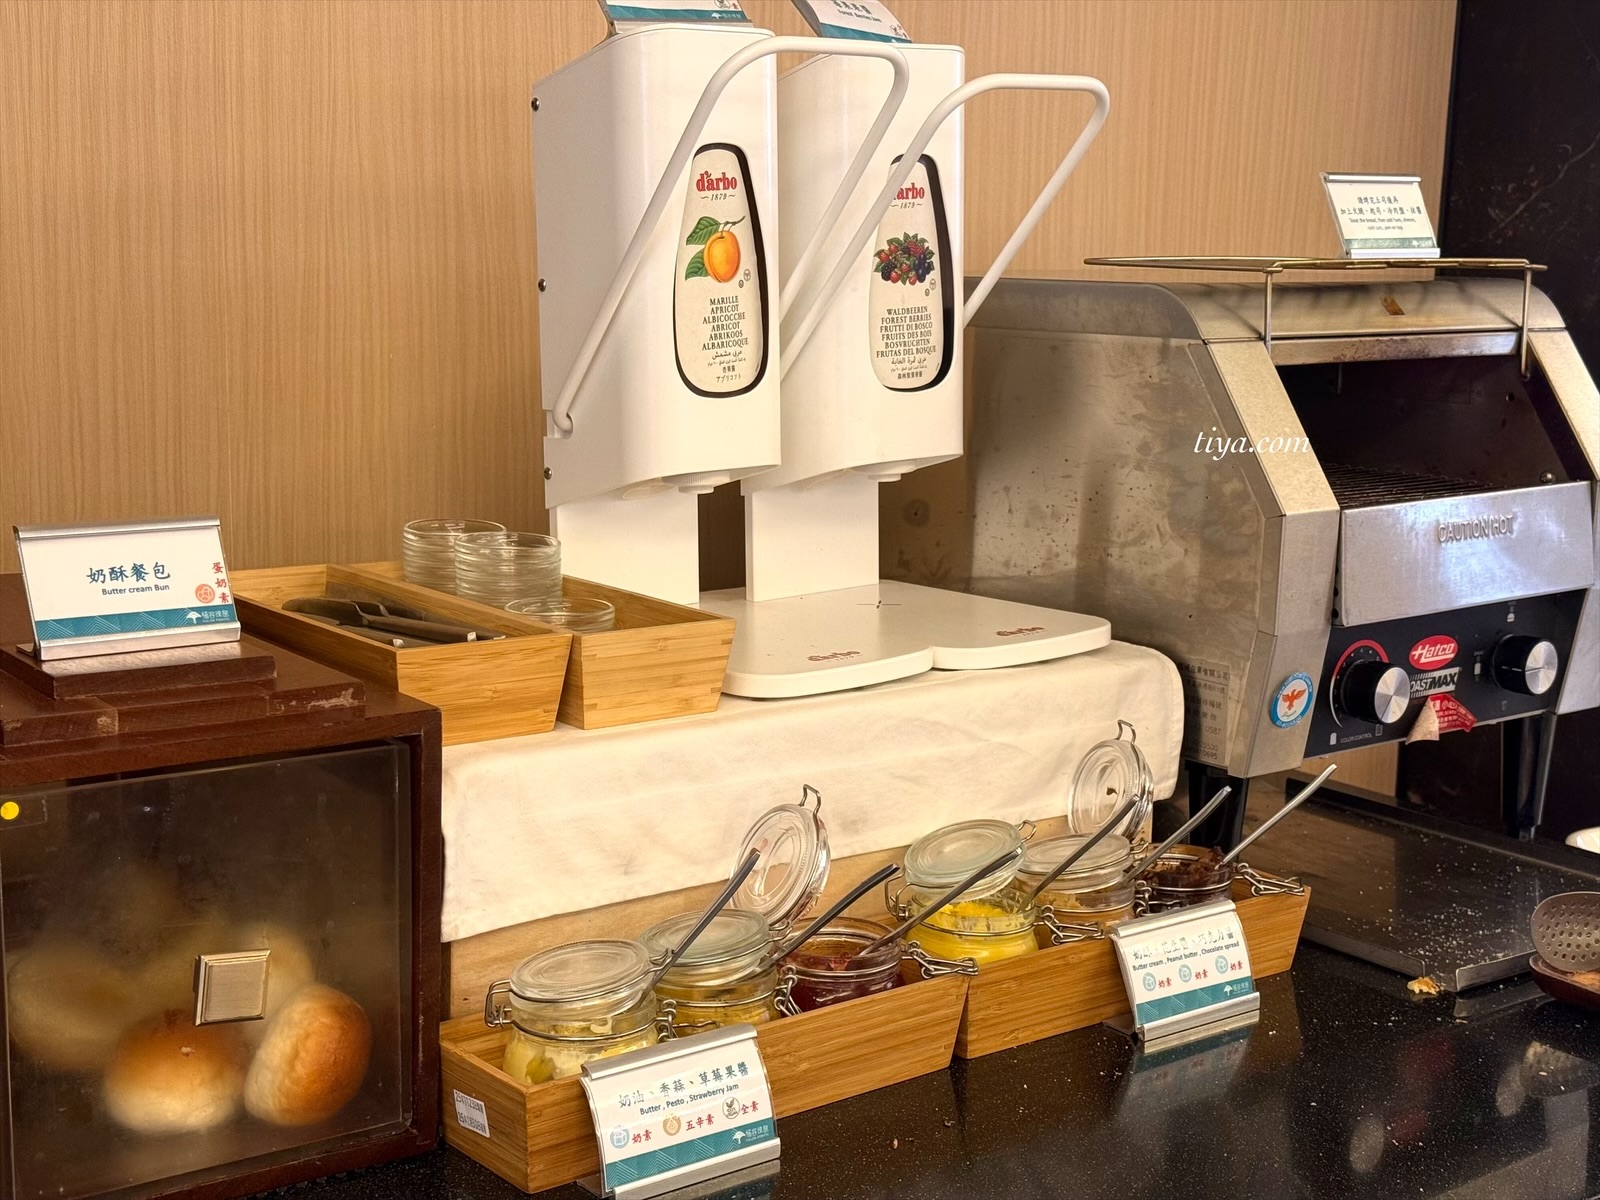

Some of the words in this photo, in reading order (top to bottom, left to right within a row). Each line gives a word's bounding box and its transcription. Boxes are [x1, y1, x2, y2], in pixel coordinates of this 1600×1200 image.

[894, 182, 925, 200] arbo
[710, 296, 739, 305] MARILLE
[710, 304, 739, 315] APRICOT
[886, 306, 928, 316] WALDBEEREN
[702, 312, 746, 324] ALBICOCCHE
[881, 316, 907, 325] FOREST
[909, 313, 932, 322] BERRIES
[711, 321, 741, 332] ABRICOT
[880, 324, 905, 333] FRUTTI
[906, 323, 914, 331] DI
[915, 321, 933, 330] BOSCO
[709, 330, 743, 341] ABRIKOOS
[881, 332, 906, 341] FRUITS
[907, 331, 919, 339] DES
[919, 330, 932, 338] BOIS
[702, 338, 749, 351] ALBARICOQUE
[885, 338, 931, 349] BOSVRUCHTEN
[876, 349, 902, 358] FRUTAS
[903, 348, 915, 356] DEL
[916, 345, 936, 355] BOSQUE
[1438, 517, 1489, 543] CAUTION
[1490, 514, 1514, 537] HOT
[86, 561, 171, 584] 奶酥餐包
[101, 587, 127, 596] Butter
[128, 585, 153, 593] cream
[154, 583, 170, 592] Bun
[212, 562, 230, 604] 蛋奶素
[1411, 643, 1455, 664] Hatco
[1410, 672, 1458, 693] OASTMAX
[1132, 963, 1148, 972] Butter
[1149, 959, 1164, 968] cream
[1166, 955, 1184, 964] Peanut
[1184, 951, 1198, 960] butter
[1201, 946, 1224, 955] Chocolate
[1224, 941, 1240, 951] spread
[1230, 960, 1243, 971] 奶素
[1195, 969, 1208, 980] 奶素
[1158, 977, 1172, 988] 奶素
[640, 1104, 661, 1115] Butter
[666, 1099, 685, 1108] Pesto
[689, 1087, 725, 1102] Strawberry
[726, 1083, 740, 1091] Jam
[740, 1101, 759, 1115] 全素
[686, 1114, 714, 1131] 五辛素
[632, 1129, 652, 1144] 奶素
